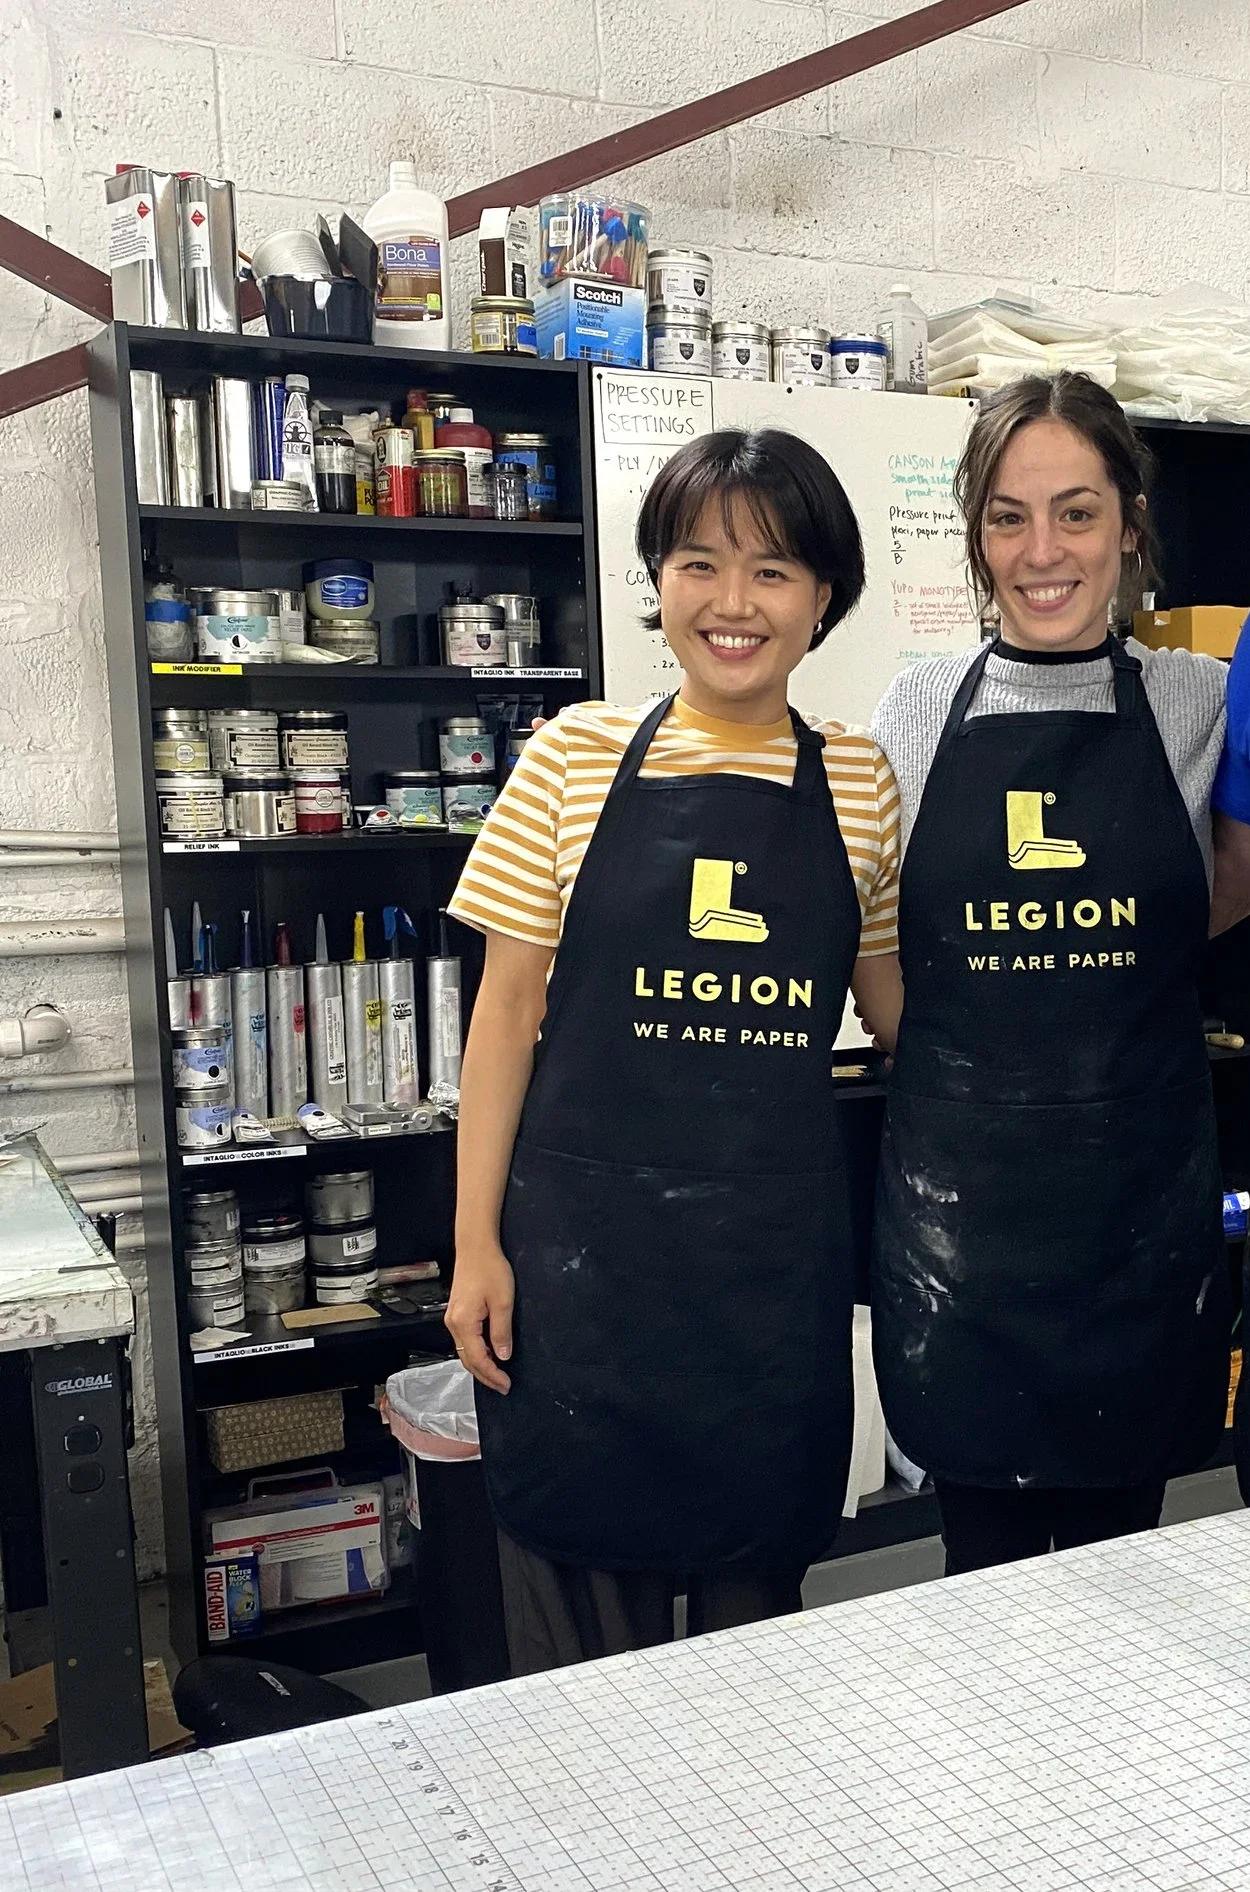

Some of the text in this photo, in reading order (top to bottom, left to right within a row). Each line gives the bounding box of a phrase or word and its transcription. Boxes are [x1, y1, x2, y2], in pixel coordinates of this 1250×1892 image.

[386, 245, 427, 261] Bona
[576, 286, 621, 305] Scotch
[915, 341, 925, 381] Arabic
[905, 360, 916, 387] Gum
[607, 381, 704, 407] PRESSURE
[607, 413, 695, 435] SETTINGS
[889, 454, 934, 470] CANSON
[889, 505, 929, 521] Pressure
[891, 580, 913, 594] YUPO
[187, 665, 221, 673] MODIFIER
[965, 898, 1136, 931] LEGION
[967, 951, 1136, 970] WE ARE PAPER
[635, 967, 813, 1008] LEGION
[634, 1022, 809, 1047] WE ARE PAPER
[203, 1154, 235, 1162] INTAGLIO
[241, 1152, 265, 1160] COLOR
[214, 1343, 290, 1359] INTAGLIO BLACK INKS
[57, 1374, 112, 1391] GLOBAL
[354, 1503, 375, 1515] 3M
[378, 1719, 394, 1729] 21
[392, 1739, 409, 1750] 20
[407, 1760, 424, 1772] 19
[422, 1782, 439, 1794] 18
[437, 1805, 455, 1816] 17
[453, 1829, 472, 1841] 16
[470, 1853, 489, 1866] 15
[488, 1879, 507, 1892] 14
